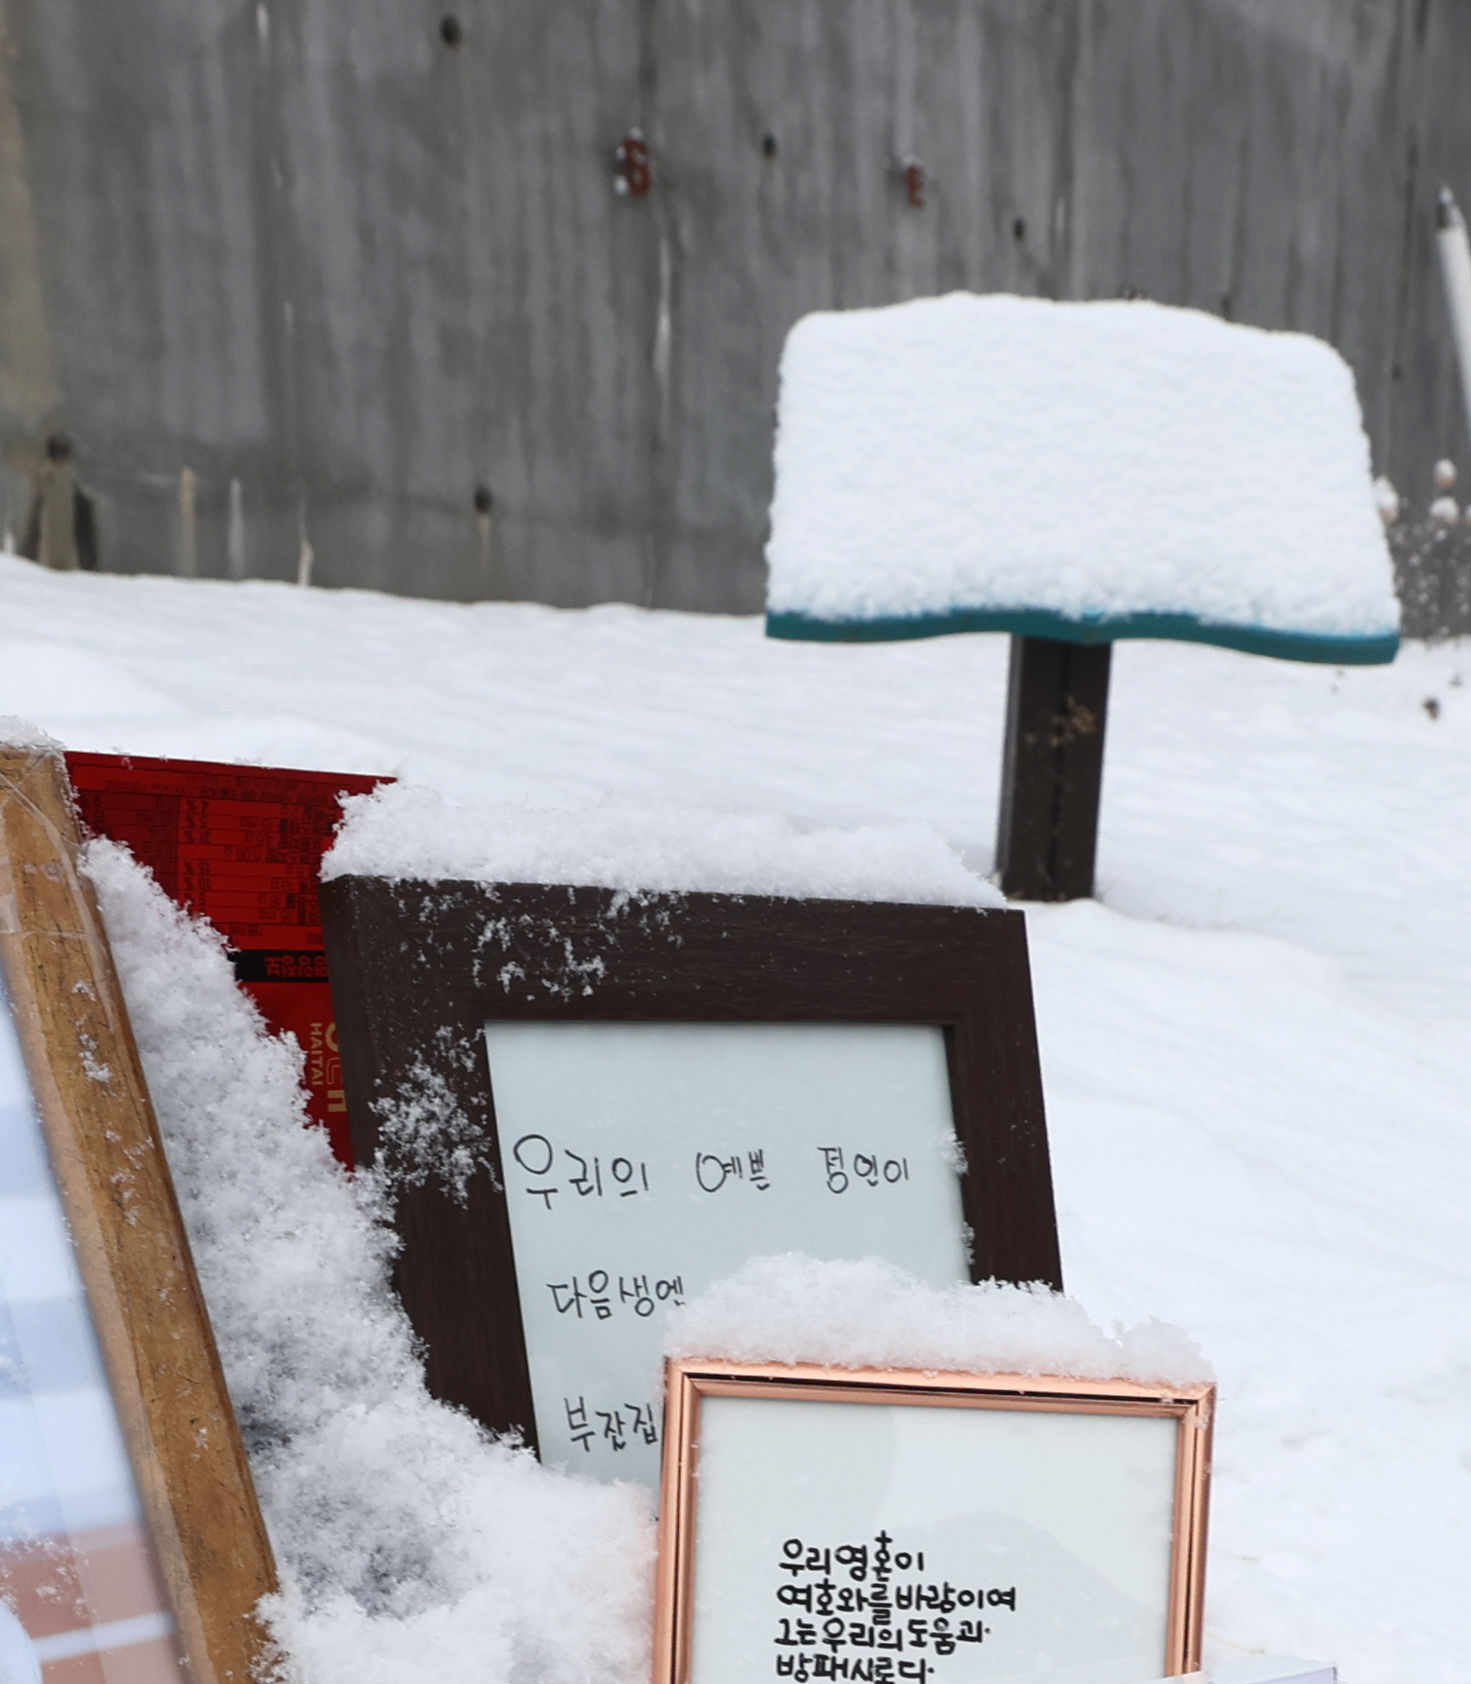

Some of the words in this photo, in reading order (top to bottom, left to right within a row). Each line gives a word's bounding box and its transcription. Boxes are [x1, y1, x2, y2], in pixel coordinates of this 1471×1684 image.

[310, 1023, 323, 1085] HAITAI
[513, 1134, 649, 1210] 우리의
[695, 1148, 771, 1193] 예쁜
[546, 1270, 686, 1320] 다음생엔
[779, 1538, 830, 1576] 우리
[834, 1530, 924, 1582] 영혼이
[776, 1578, 893, 1626] 여호와를
[774, 1619, 818, 1646] 그는
[822, 1617, 904, 1653] 우리의
